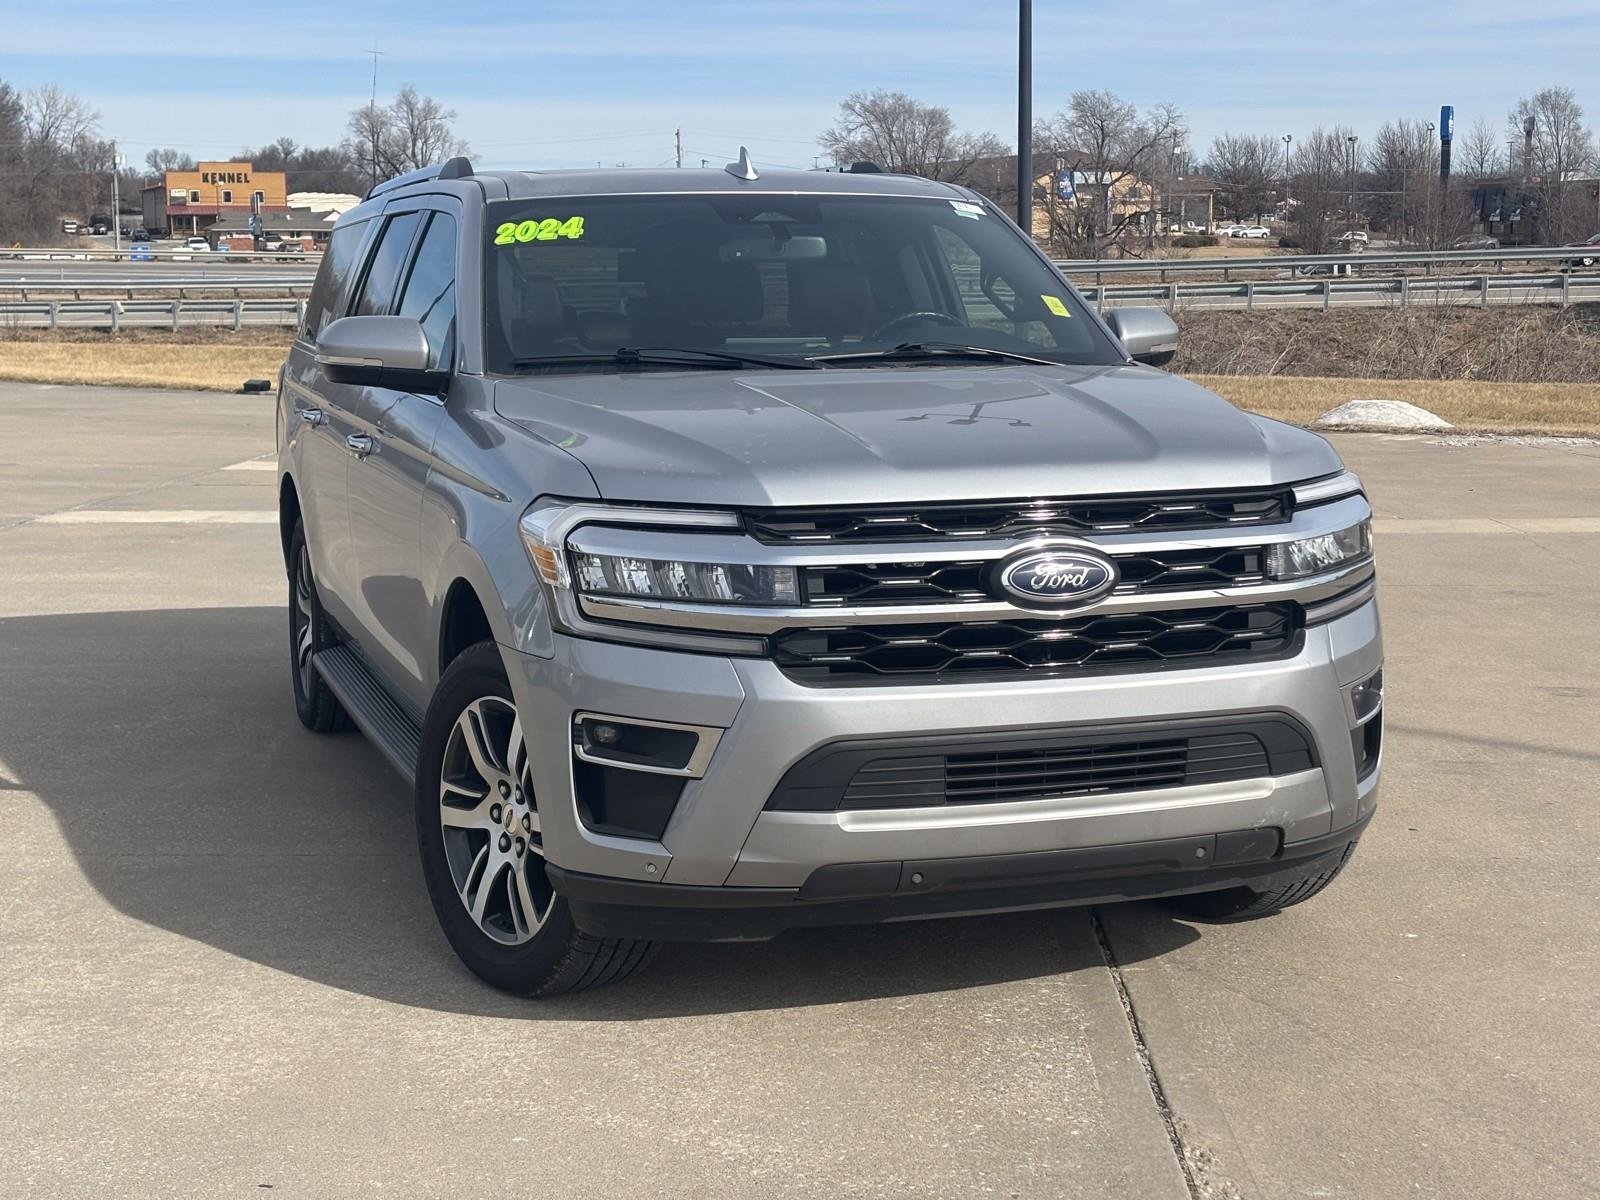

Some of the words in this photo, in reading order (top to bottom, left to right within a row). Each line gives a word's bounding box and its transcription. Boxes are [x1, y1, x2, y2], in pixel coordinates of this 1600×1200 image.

[202, 172, 250, 184] KENNEL
[494, 216, 584, 245] 2024
[1030, 562, 1089, 590] Ford
